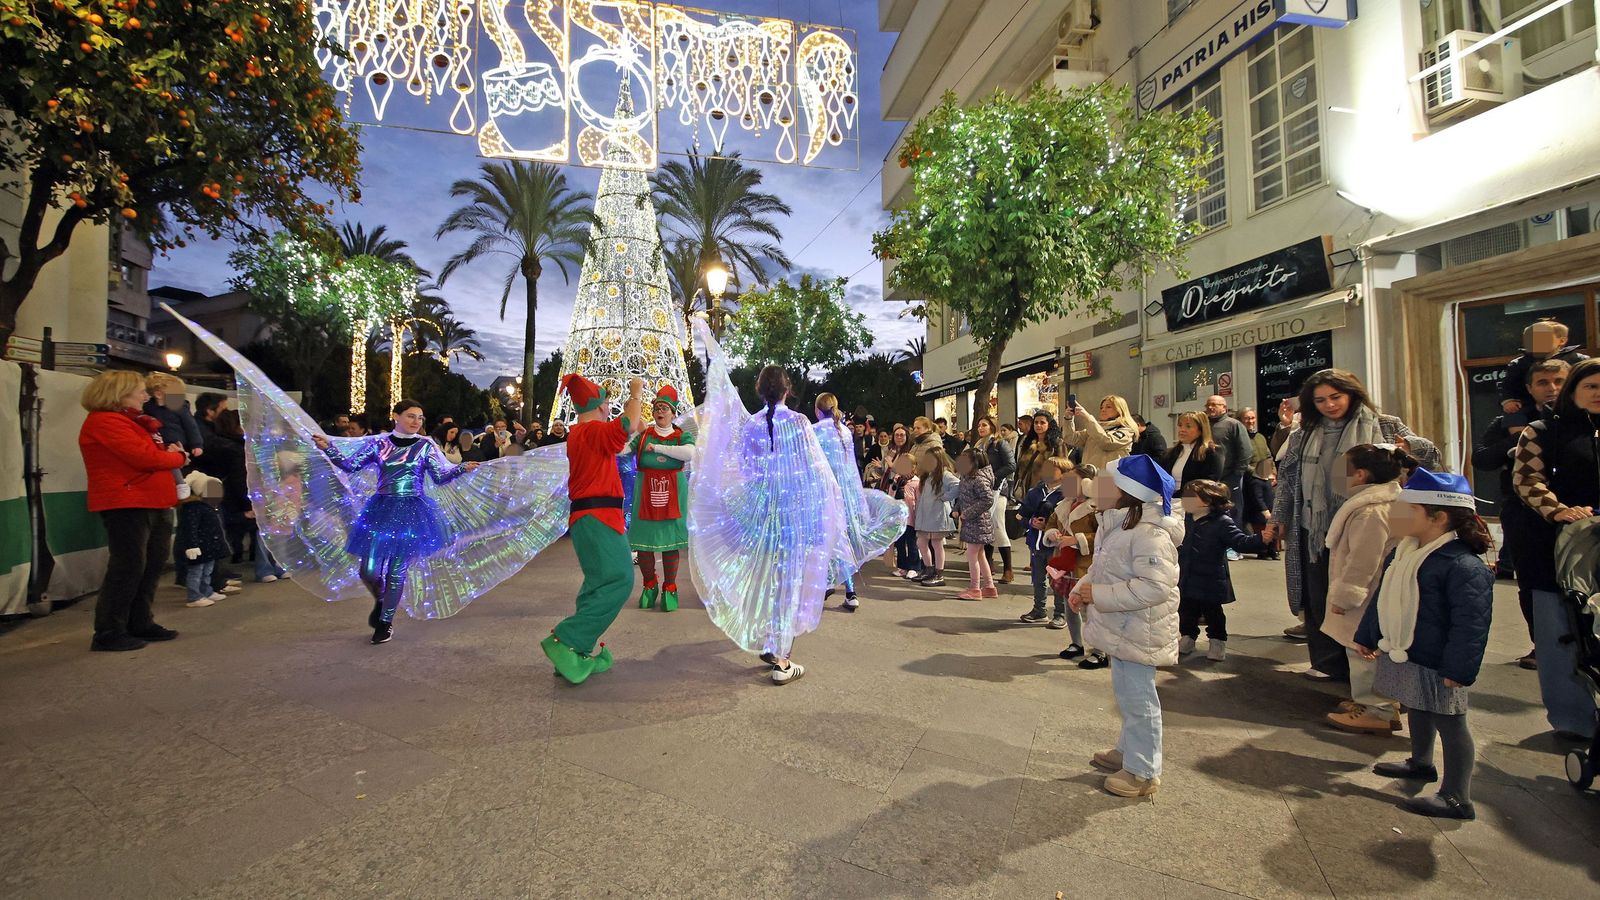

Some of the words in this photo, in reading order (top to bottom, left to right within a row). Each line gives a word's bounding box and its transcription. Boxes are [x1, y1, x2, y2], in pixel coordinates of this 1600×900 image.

[1162, 31, 1230, 91] PATRIA
[1234, 0, 1275, 38] HIS
[1181, 264, 1297, 319] Dieguito
[1165, 339, 1205, 362] CAFÉ
[1211, 318, 1306, 353] DIEGUITO
